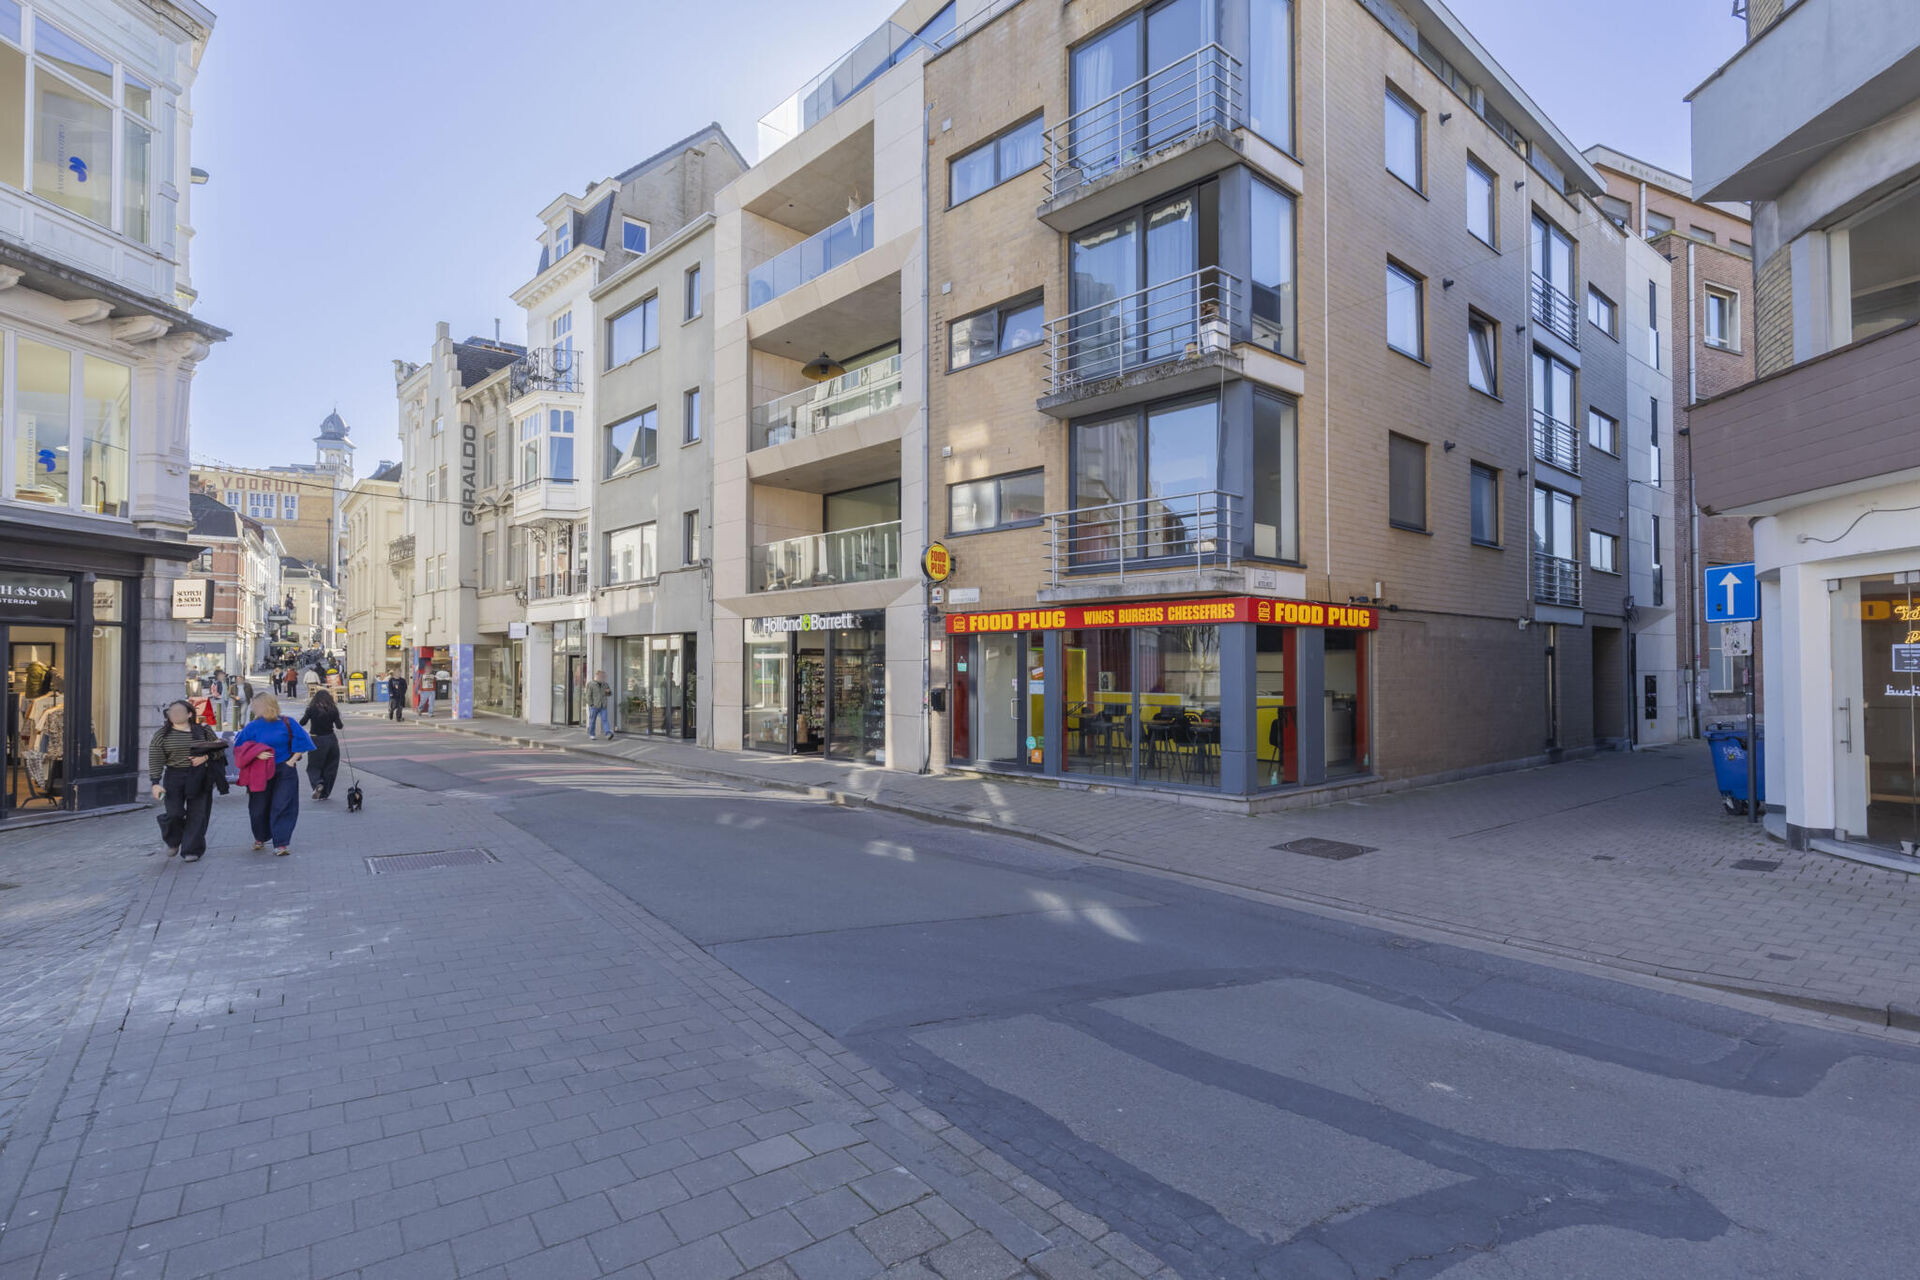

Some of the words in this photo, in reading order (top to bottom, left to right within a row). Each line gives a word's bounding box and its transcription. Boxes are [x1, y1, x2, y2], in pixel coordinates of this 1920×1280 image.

[462, 424, 476, 526] GIRALDO
[930, 550, 947, 563] FOOD
[930, 562, 947, 575] PLUG
[28, 586, 67, 599] SODA
[969, 613, 1014, 632] FOOD
[1018, 610, 1066, 629] PLUG
[1083, 610, 1115, 625] WINGS
[1118, 606, 1164, 623] BURGERS
[1167, 602, 1235, 621] CHEESEFRIES
[1275, 602, 1324, 625] FOOD
[1327, 606, 1370, 628] PLUG
